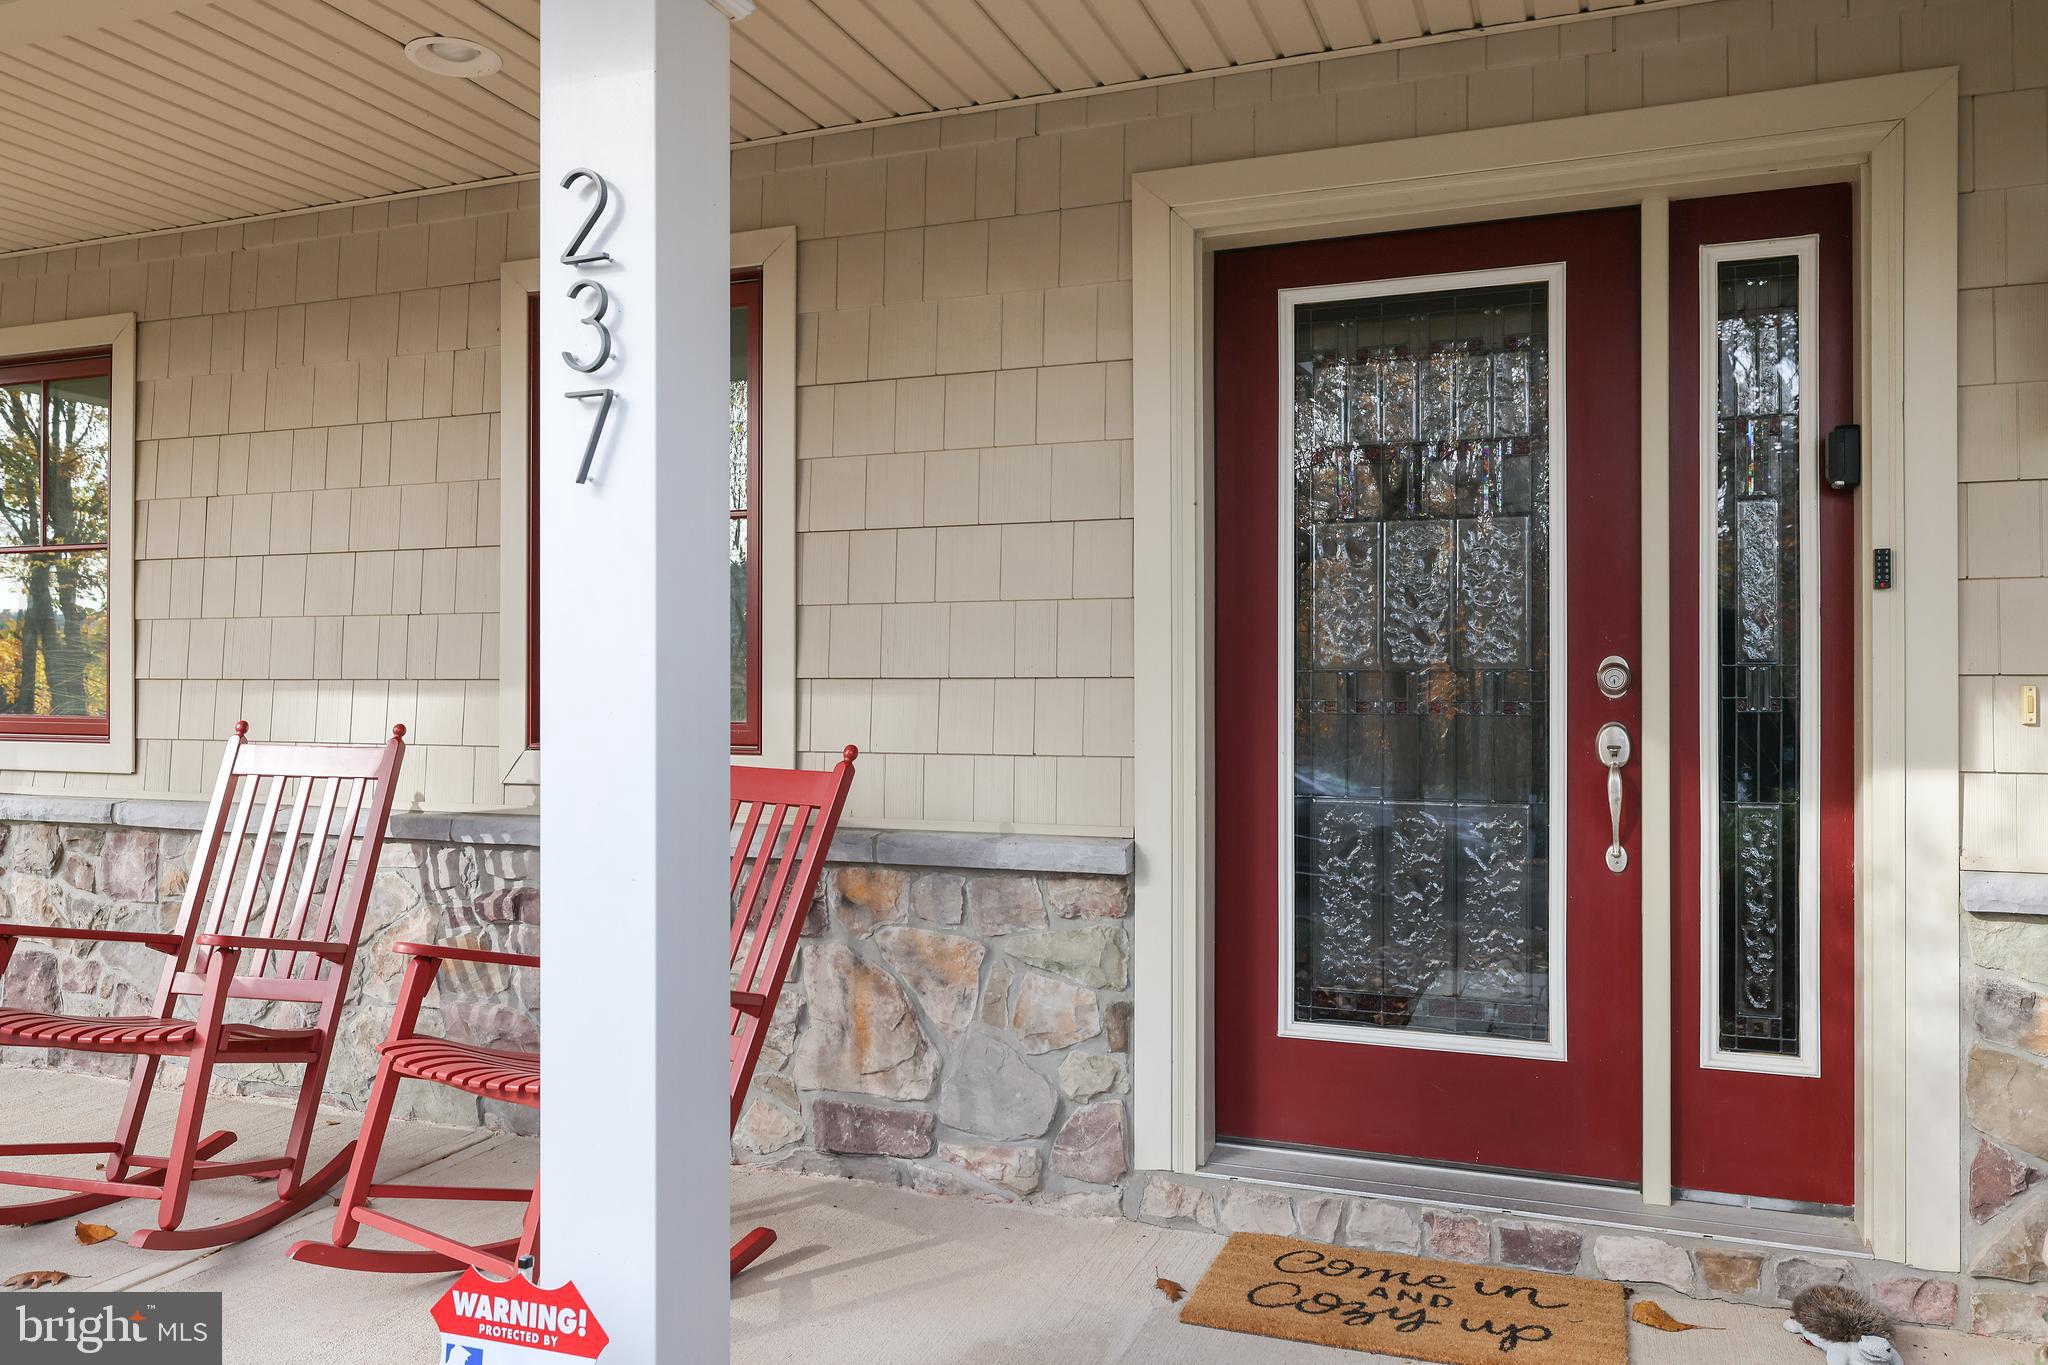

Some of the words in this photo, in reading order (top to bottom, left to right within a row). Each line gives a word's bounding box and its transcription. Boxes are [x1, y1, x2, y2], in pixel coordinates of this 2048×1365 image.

[560, 167, 616, 484] 237
[1273, 1249, 1456, 1290] Come
[1474, 1278, 1569, 1309] in
[1367, 1286, 1453, 1309] AND
[452, 1289, 587, 1337] WARNING!
[478, 1323, 540, 1344] PROTECTED
[543, 1334, 559, 1347] BY
[1247, 1281, 1441, 1333] Cozy
[1460, 1315, 1553, 1352] up
